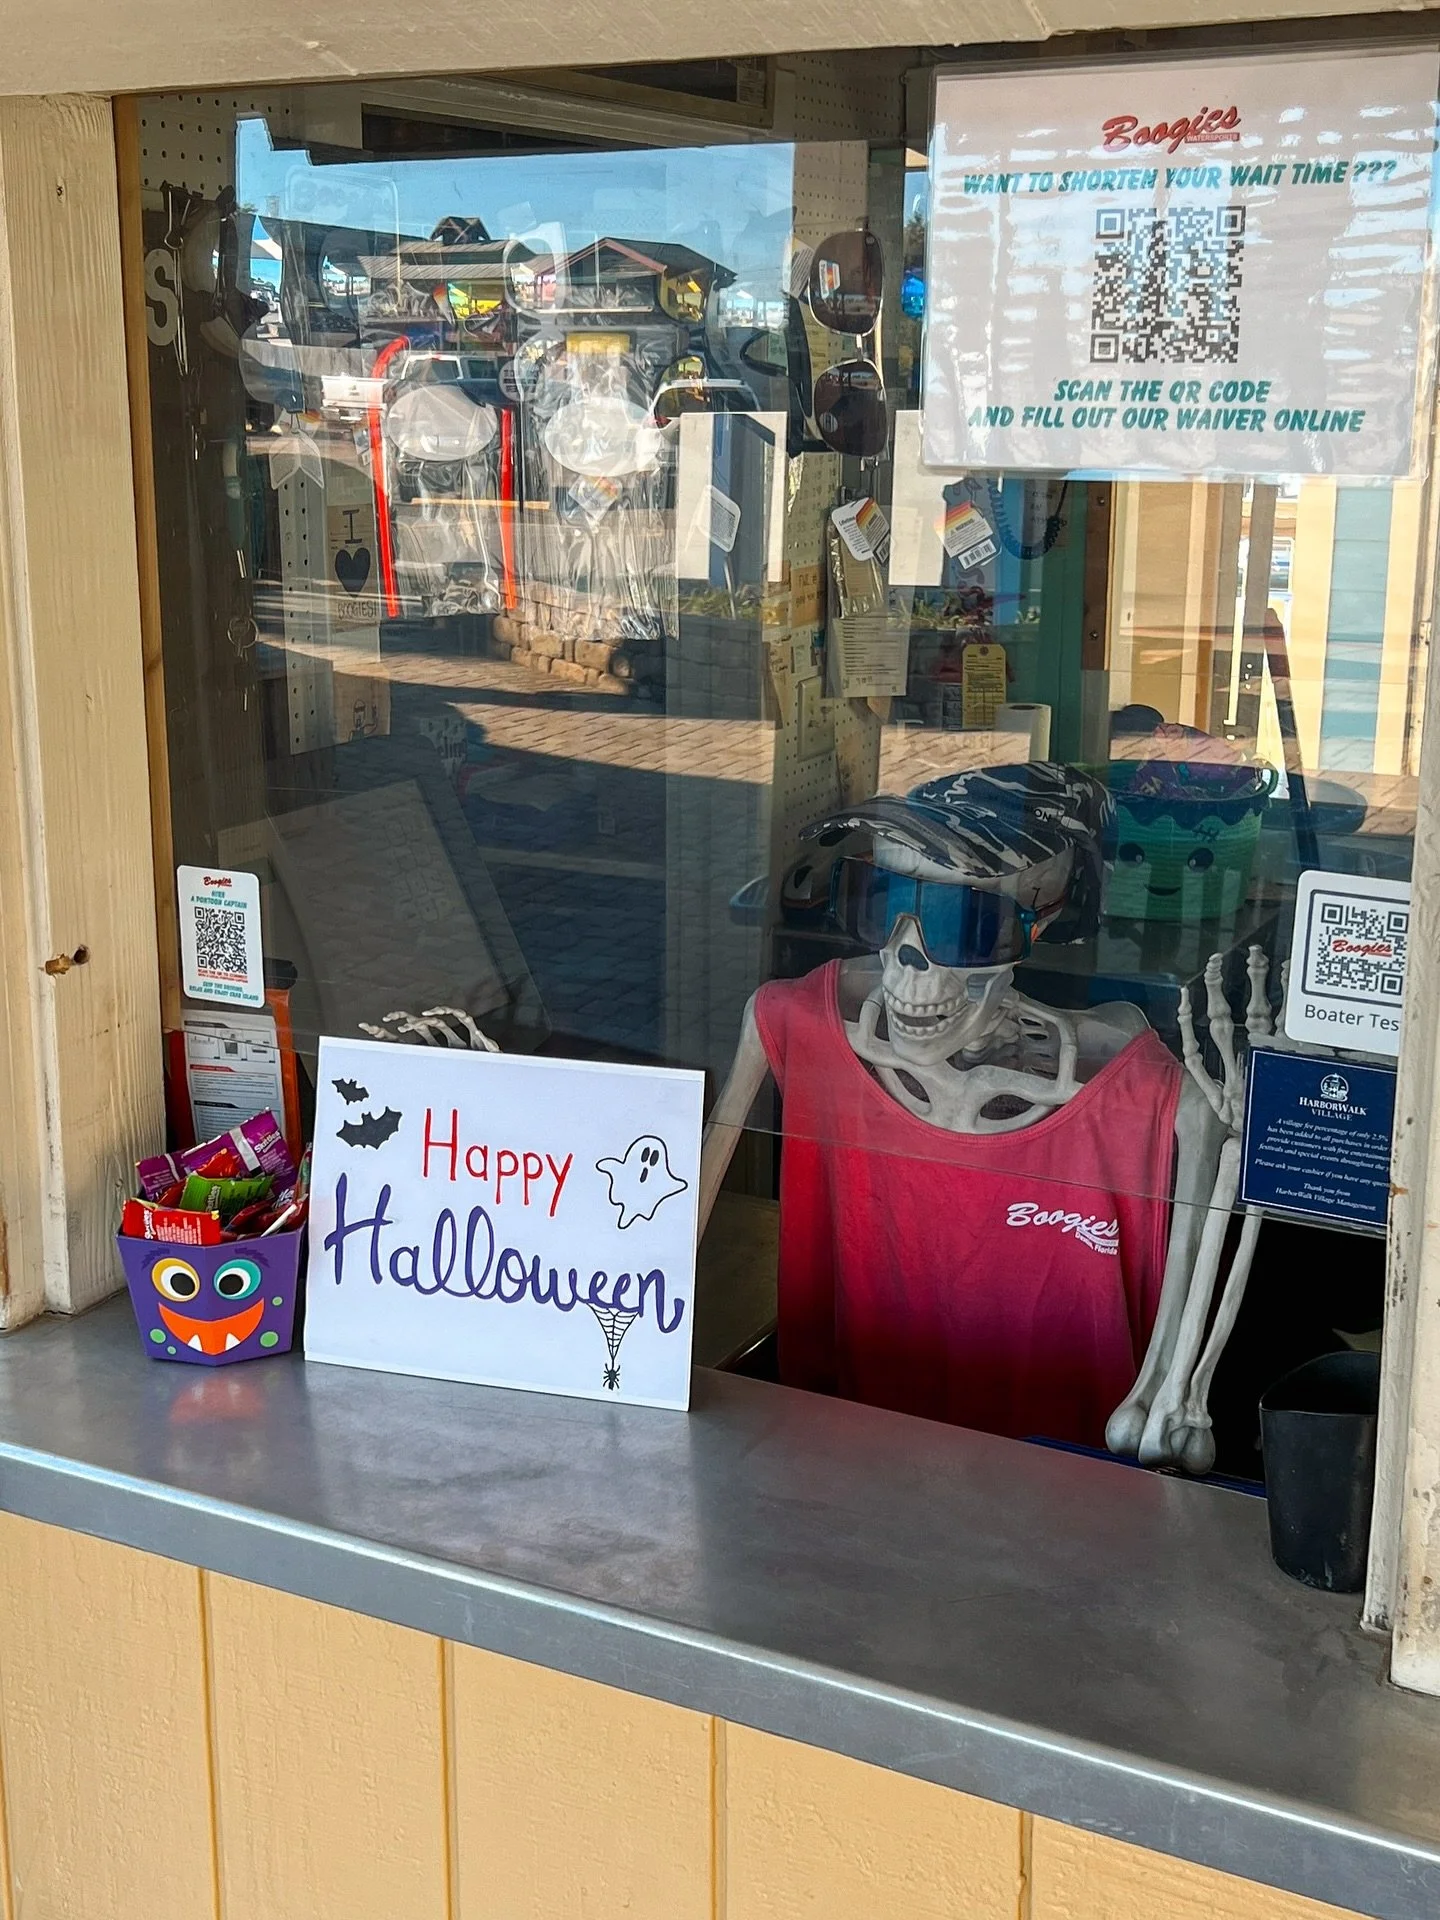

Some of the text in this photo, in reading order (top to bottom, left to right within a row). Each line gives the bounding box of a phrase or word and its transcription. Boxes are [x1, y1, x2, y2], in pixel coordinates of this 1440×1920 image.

[1101, 106, 1242, 155] Boogies
[963, 173, 1023, 195] WANT
[1028, 171, 1054, 193] TO
[1057, 168, 1159, 192] SHORTEN
[1165, 167, 1222, 189] YOUR
[1229, 164, 1287, 187] WAIT
[1291, 161, 1350, 185] TIME
[1054, 380, 1273, 404] SCAN THE QR CODE
[968, 406, 1367, 433] AND FILL OUT OUR WAIVER ONLINE
[1332, 939, 1393, 957] Boogies
[1304, 1004, 1400, 1032] Boater Tes
[1299, 1097, 1367, 1115] HARBORWALK
[1311, 1107, 1353, 1121] VILLAGE
[422, 1107, 574, 1218] Happy
[1006, 1202, 1120, 1237] Boogies
[323, 1171, 686, 1334] Halloween
